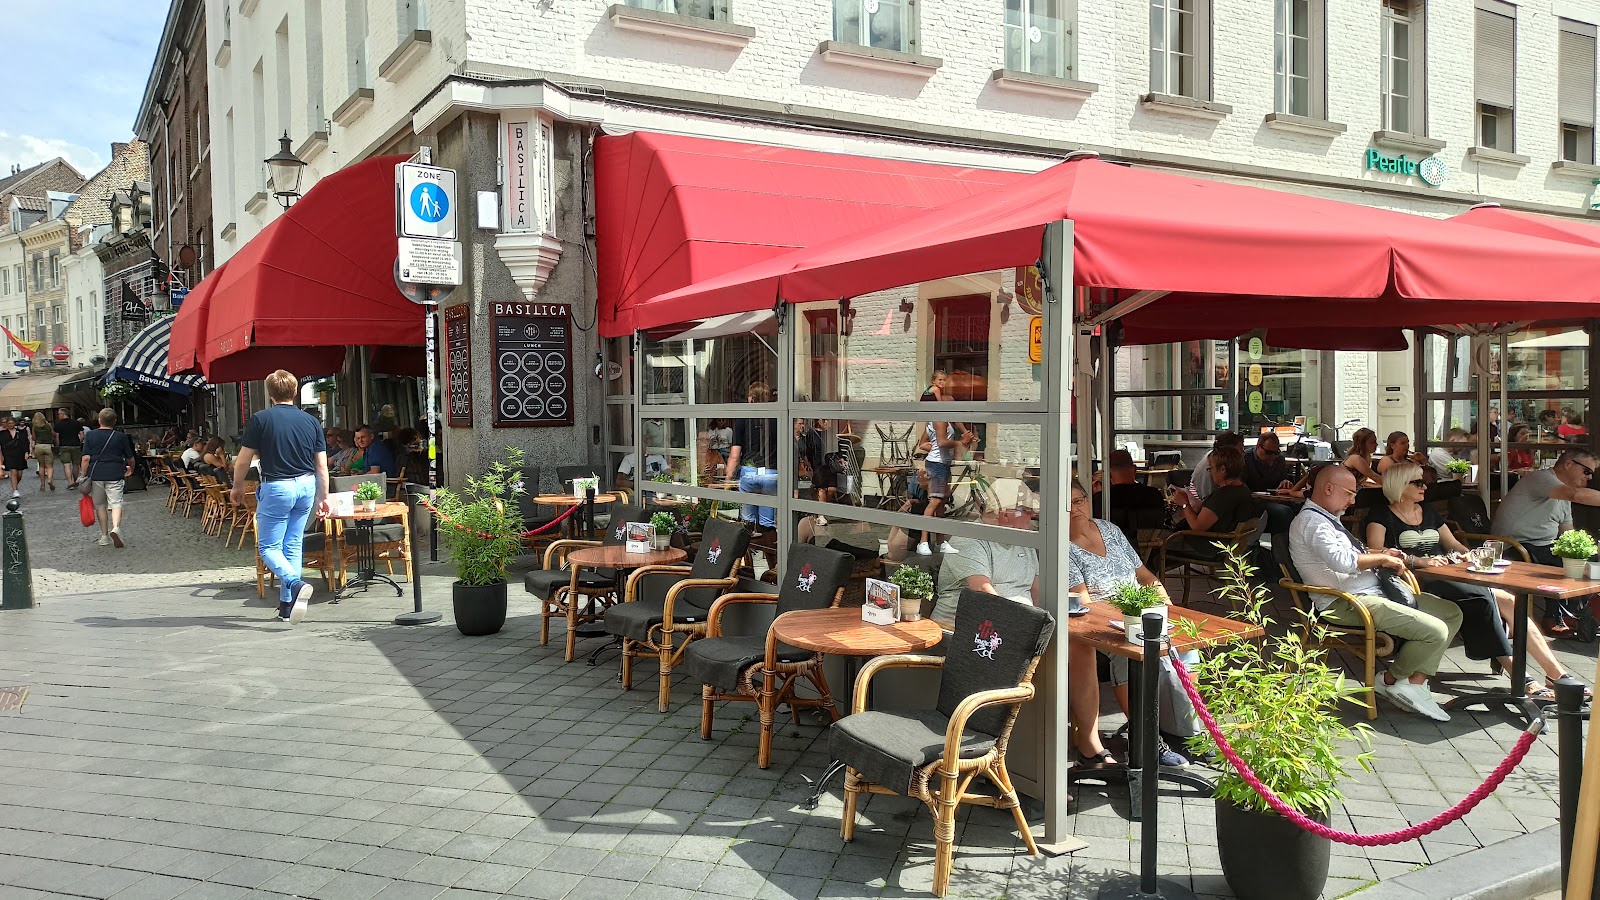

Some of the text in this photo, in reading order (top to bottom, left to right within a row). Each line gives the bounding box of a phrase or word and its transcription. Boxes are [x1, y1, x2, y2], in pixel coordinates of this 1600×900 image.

[1366, 148, 1418, 176] Pearle
[417, 170, 442, 181] ZONE
[515, 127, 526, 226] BASILICA
[495, 303, 567, 316] BASILICA
[138, 373, 170, 388] Bavaria
